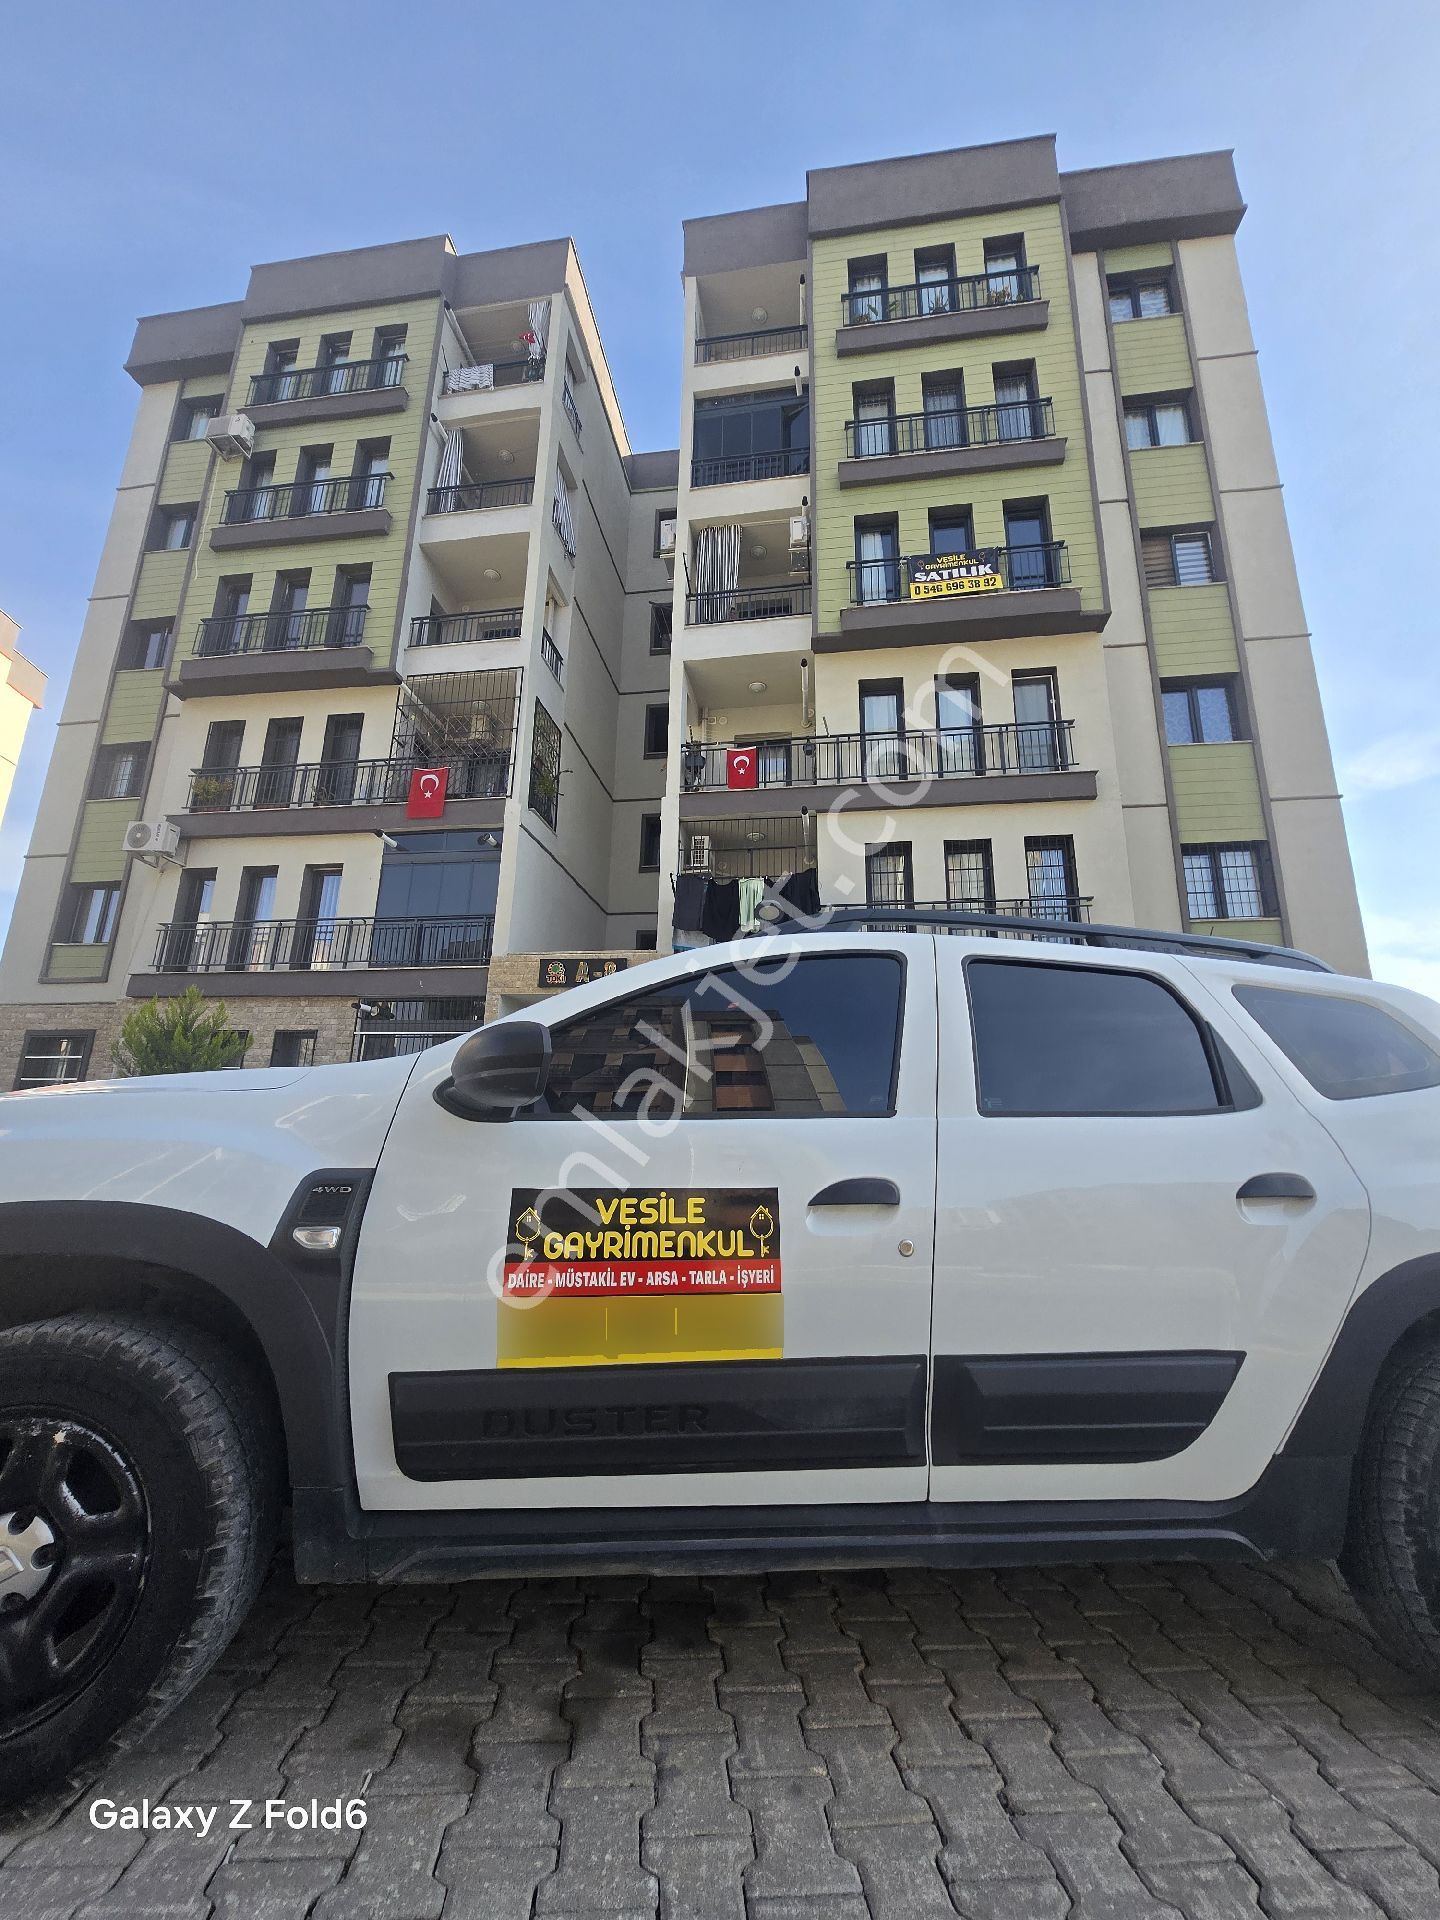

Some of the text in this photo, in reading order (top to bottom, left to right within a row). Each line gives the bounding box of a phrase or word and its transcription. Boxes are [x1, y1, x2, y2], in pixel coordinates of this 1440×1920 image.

[914, 577, 997, 595] 0 546 696 38 92
[915, 564, 993, 582] SATILIK
[596, 1191, 706, 1225] VESİLE
[543, 1224, 755, 1260] GAYRİMENKUL
[507, 1271, 545, 1289] DAİRE
[555, 1267, 618, 1288] MÜSTAKİL
[620, 1272, 636, 1287] EV
[646, 1270, 679, 1286] ARSA
[688, 1269, 728, 1285] TARLA
[737, 1265, 775, 1288] İŞYERİ
[482, 1404, 709, 1439] DUSTER
